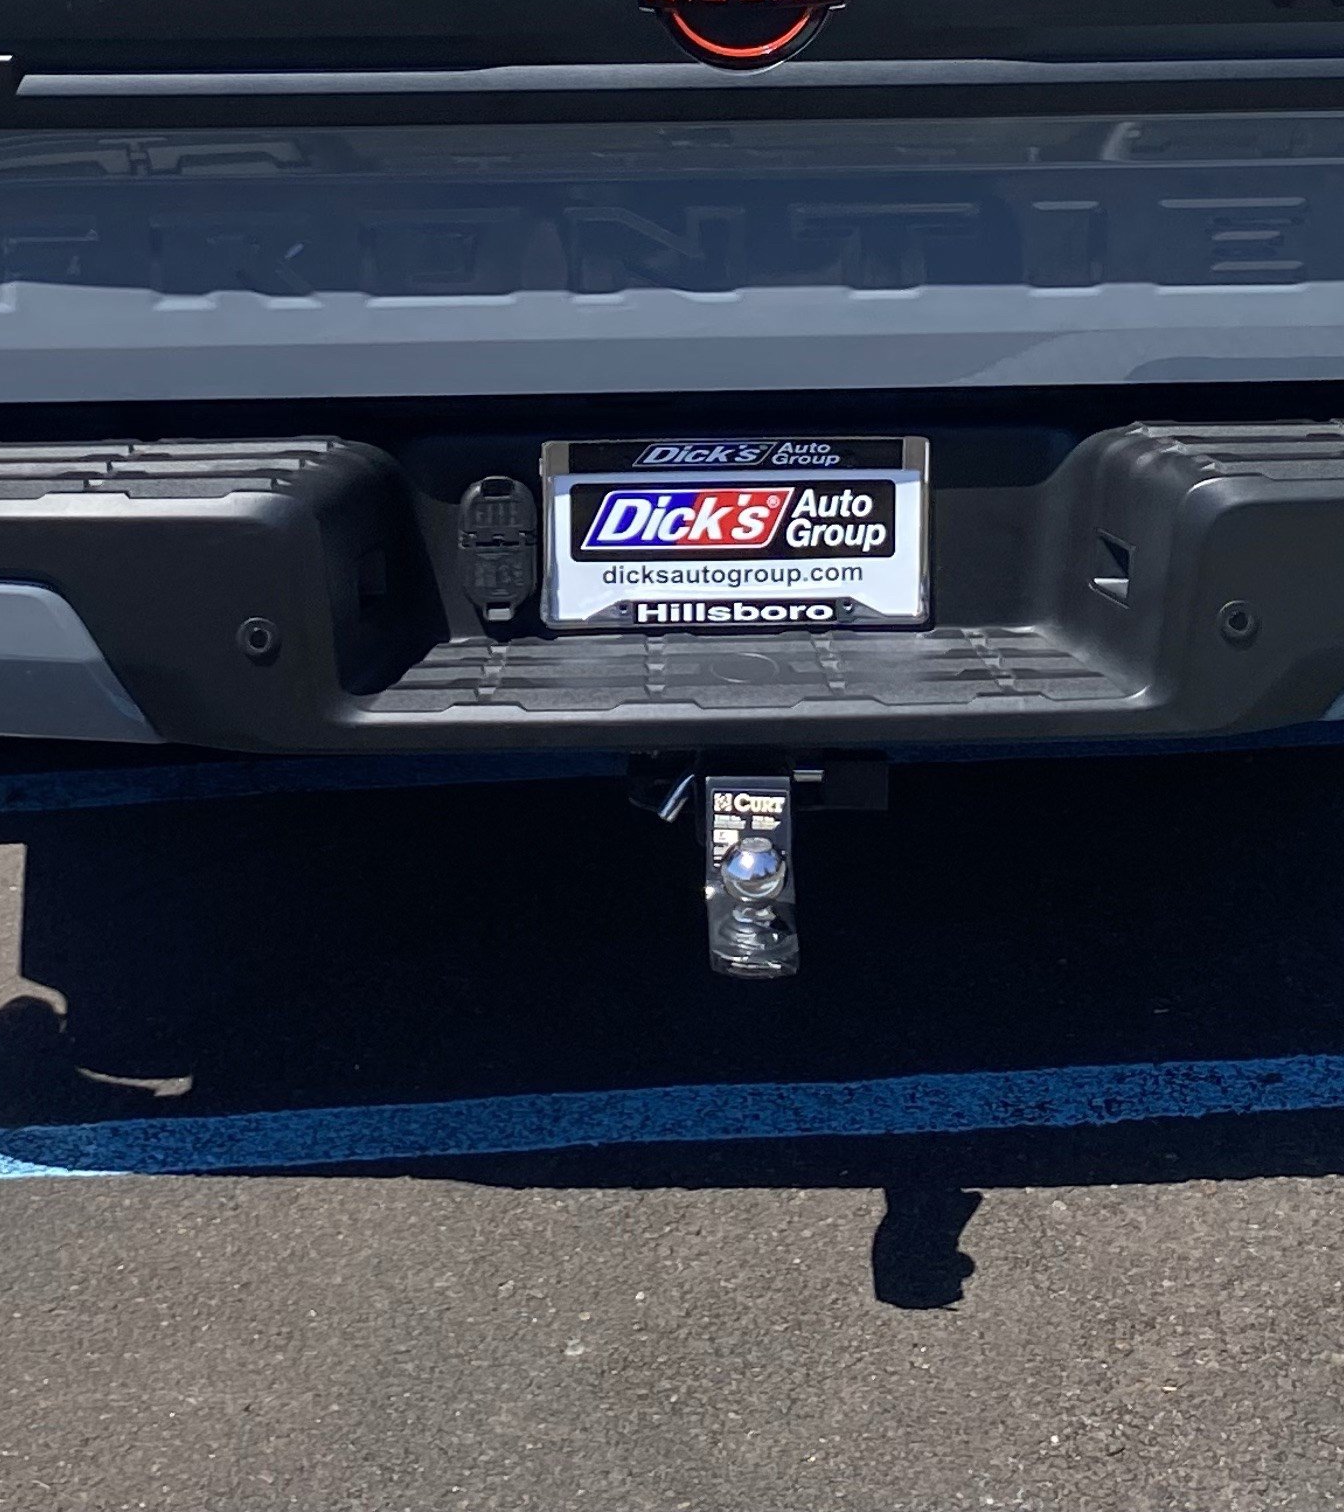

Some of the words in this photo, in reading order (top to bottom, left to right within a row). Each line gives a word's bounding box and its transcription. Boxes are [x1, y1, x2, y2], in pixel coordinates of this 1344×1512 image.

[771, 452, 841, 467] Group
[777, 441, 831, 455] Auto
[791, 488, 874, 519] Auto
[785, 519, 887, 553] Group
[602, 563, 864, 589] dicksautogroup.com
[636, 601, 835, 624] Hillsboro
